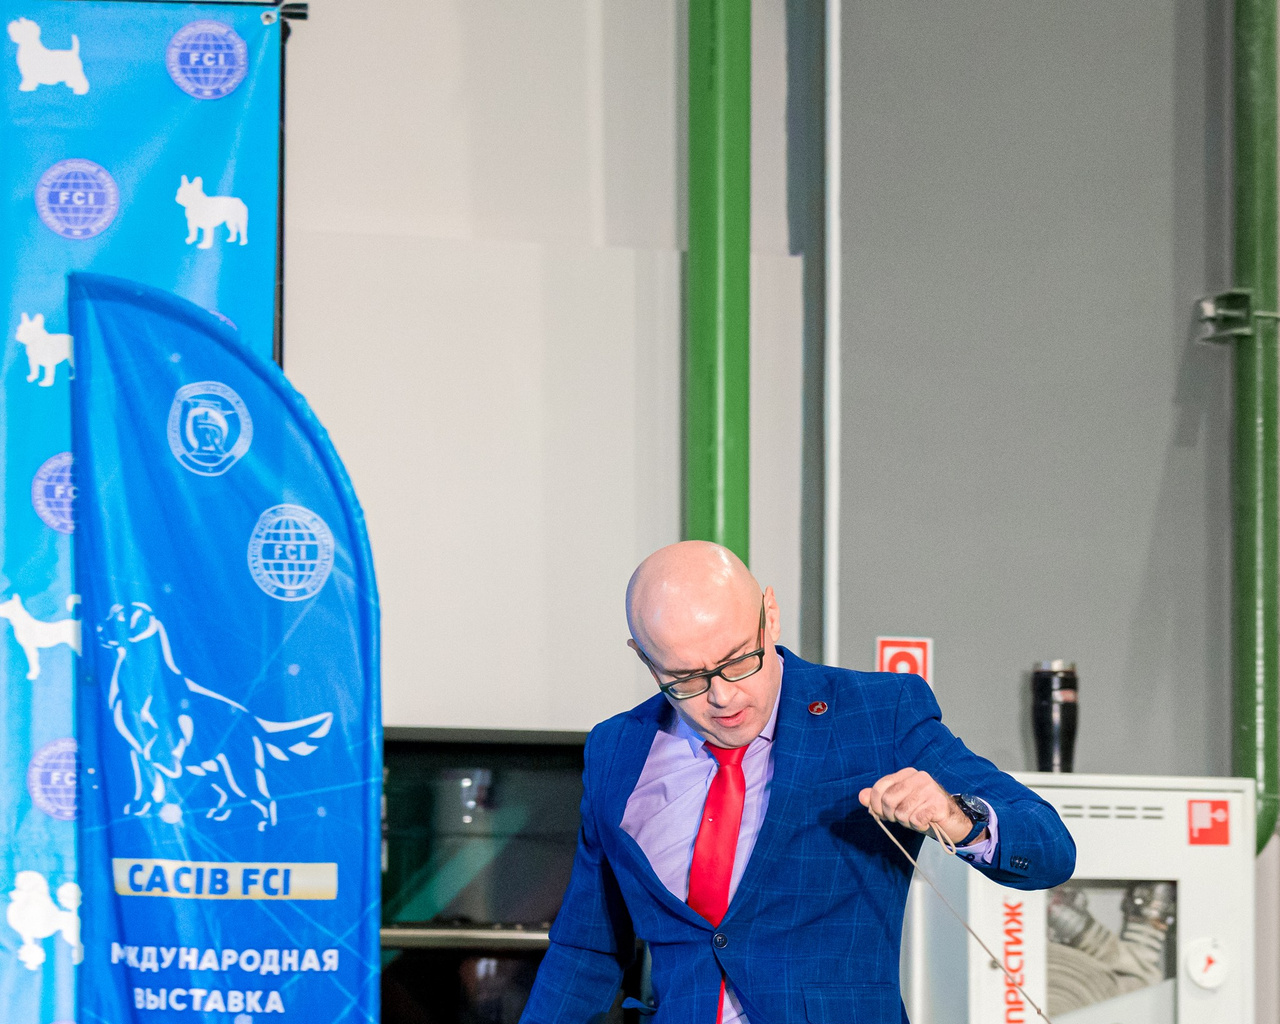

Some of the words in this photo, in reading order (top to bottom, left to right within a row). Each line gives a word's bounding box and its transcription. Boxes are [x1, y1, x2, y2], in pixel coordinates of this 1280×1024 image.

[189, 53, 225, 66] FCI
[59, 192, 95, 205] FCI
[54, 485, 79, 500] FC
[273, 544, 307, 560] FCI
[50, 772, 77, 786] FC
[128, 864, 230, 895] CACIB
[241, 868, 291, 896] FCI
[1003, 901, 1025, 1024] ПРЕСТИЖ
[134, 987, 285, 1013] ВЫСТАВКА
